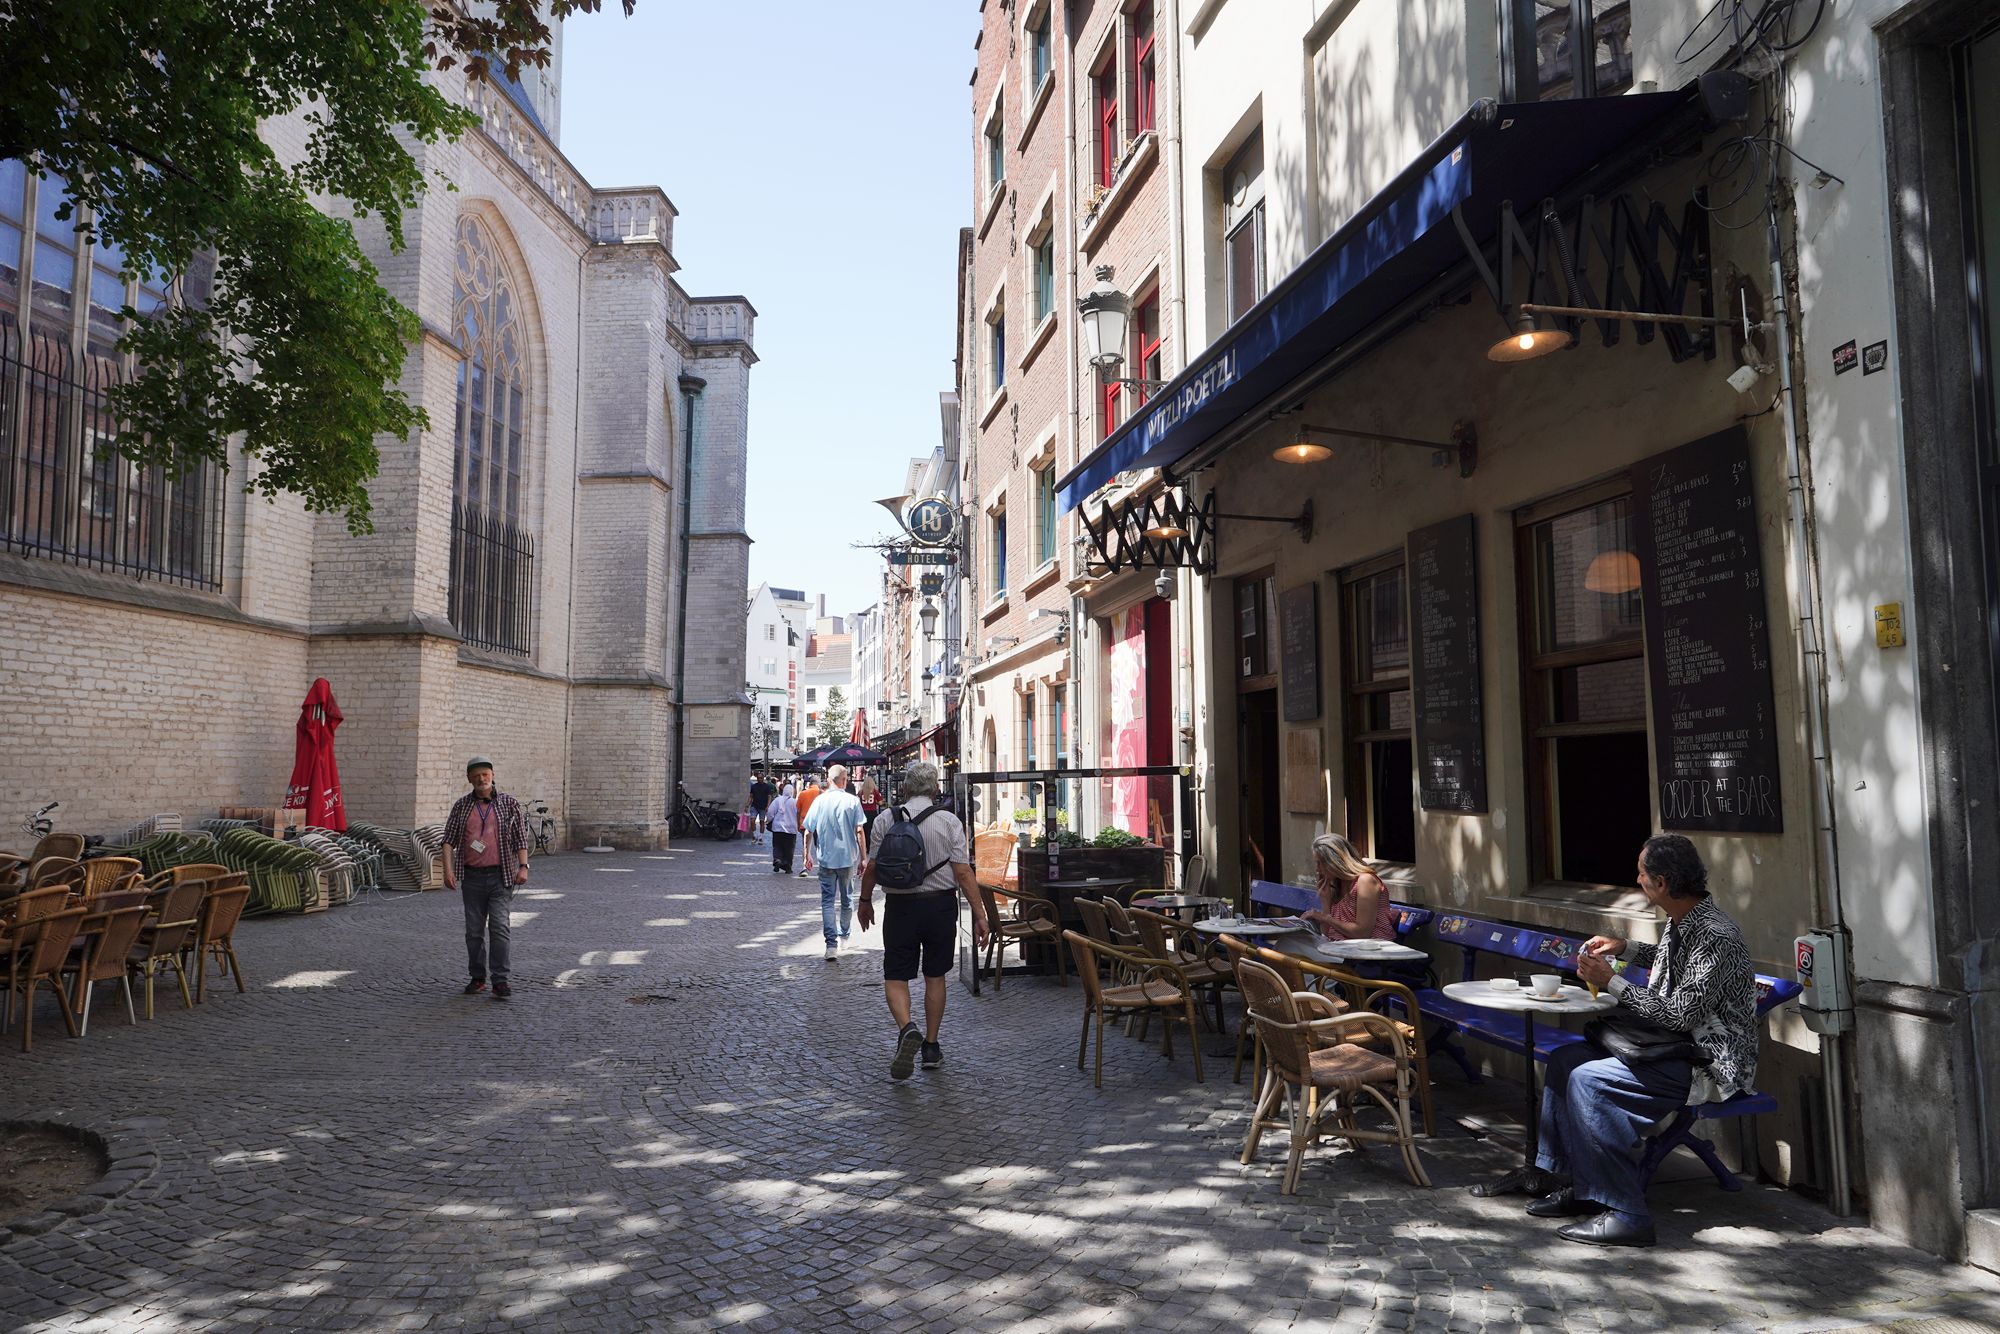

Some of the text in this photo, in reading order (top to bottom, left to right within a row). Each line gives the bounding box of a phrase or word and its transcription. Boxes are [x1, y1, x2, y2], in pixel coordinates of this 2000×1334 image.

[1147, 349, 1236, 441] WITZLI-POETZLI
[908, 555, 937, 564] HOTEL
[1716, 778, 1728, 792] AT
[1662, 779, 1711, 819] ORDER
[1715, 796, 1733, 813] THE
